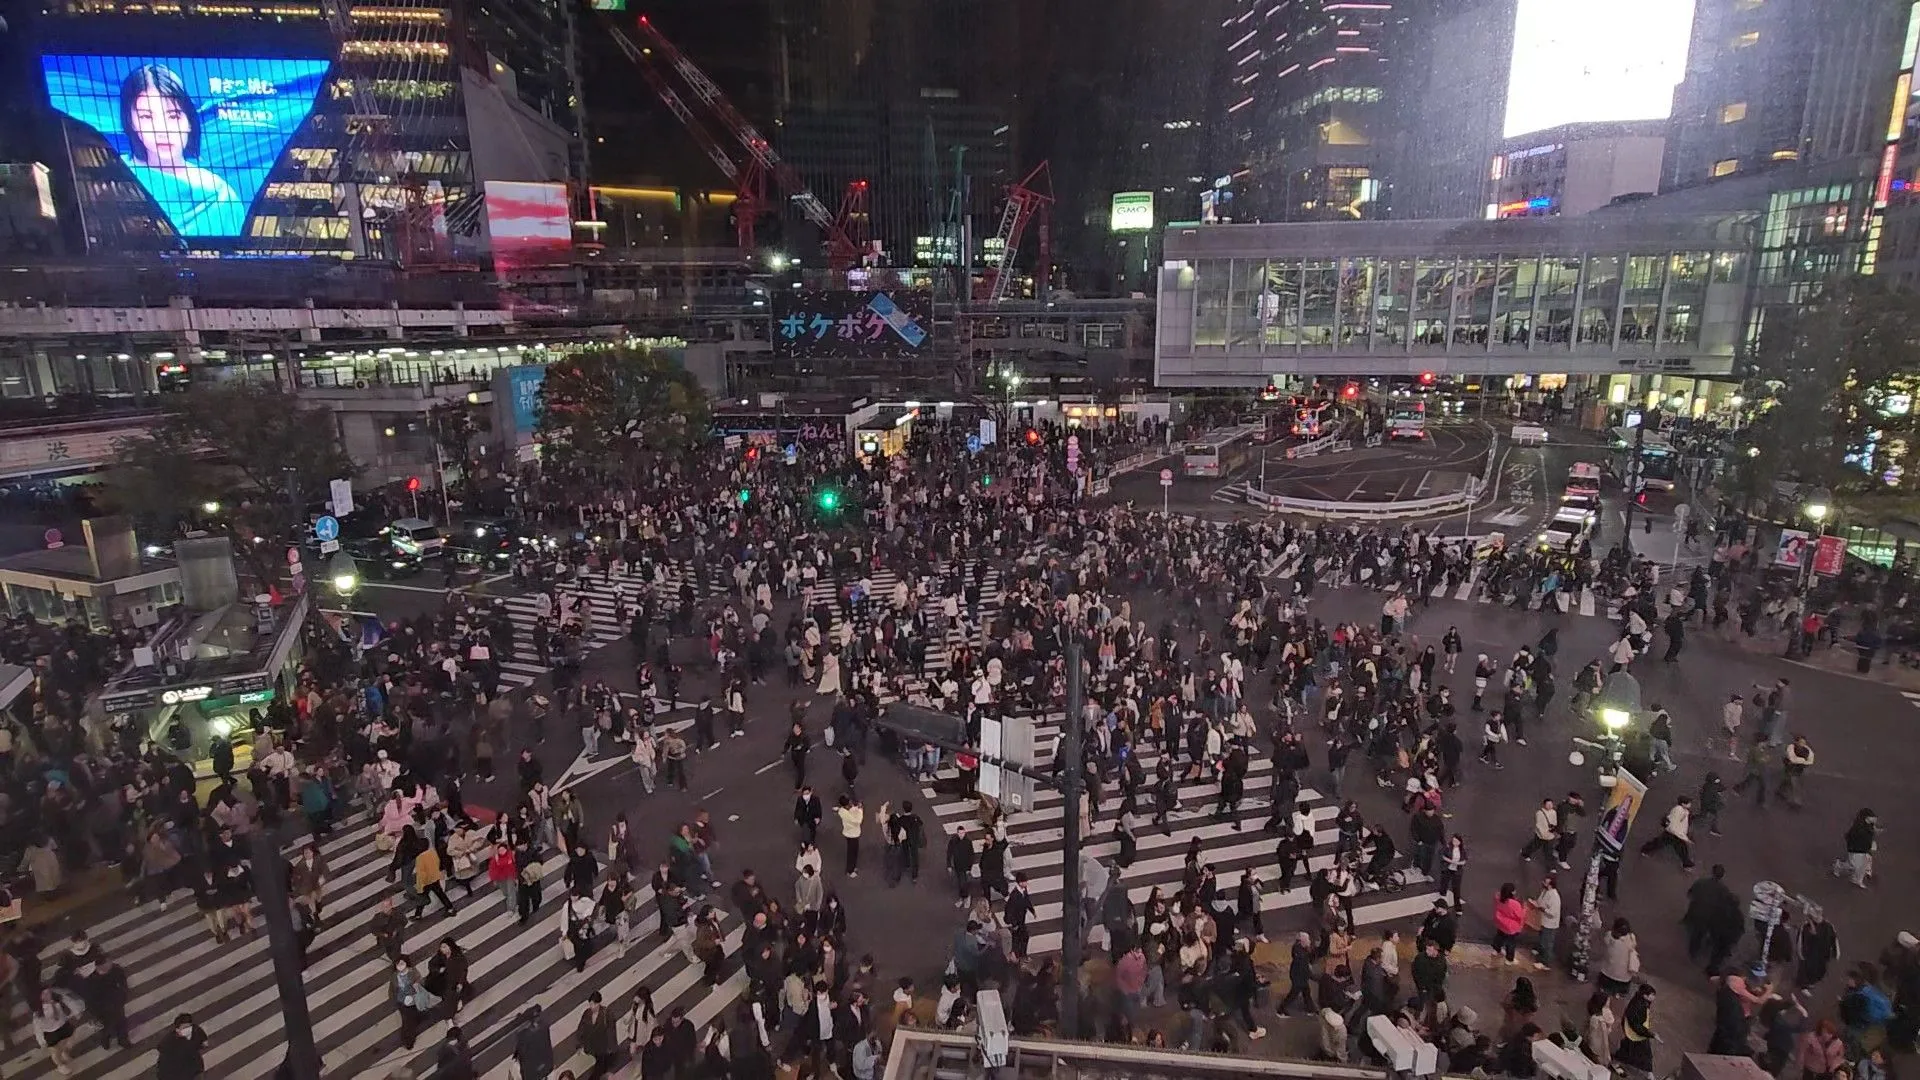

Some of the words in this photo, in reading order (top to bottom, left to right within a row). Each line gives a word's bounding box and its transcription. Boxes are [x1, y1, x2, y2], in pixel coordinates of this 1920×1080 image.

[1117, 206, 1147, 214] GMO
[779, 311, 889, 339] ポケポケ
